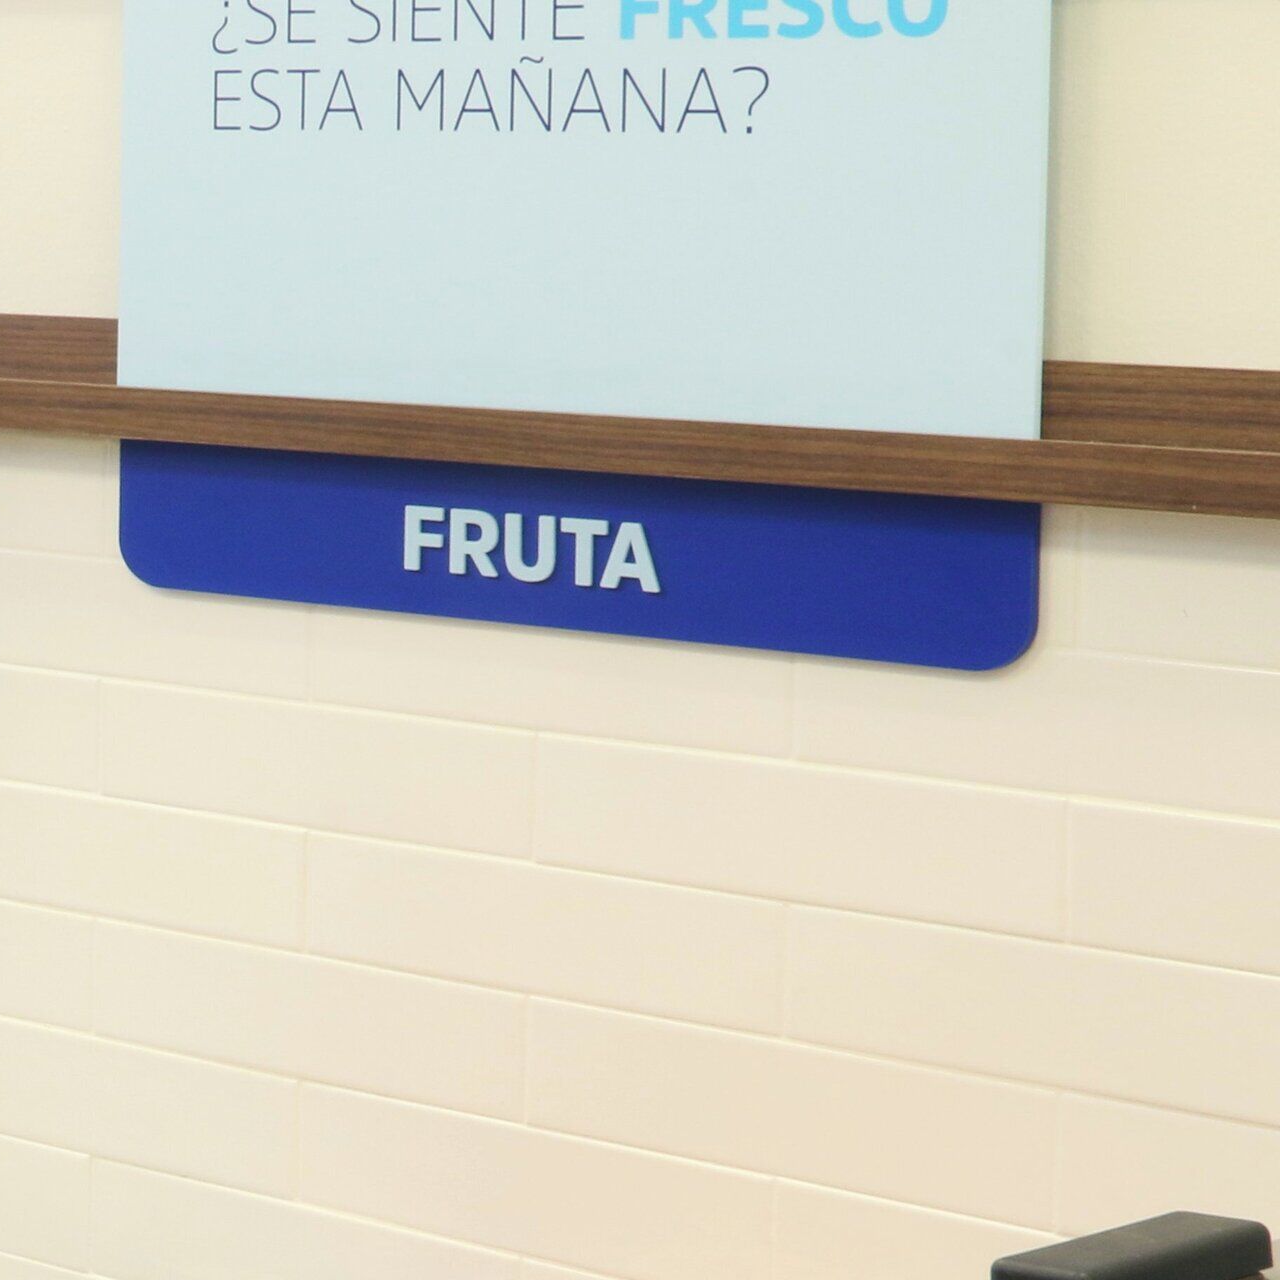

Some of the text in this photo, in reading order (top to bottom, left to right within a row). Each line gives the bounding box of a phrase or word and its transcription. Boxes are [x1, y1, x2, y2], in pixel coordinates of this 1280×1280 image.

[212, 0, 949, 54] ¿SE SIENTE FRESCO
[213, 55, 770, 135] ESTA MAÑANA?
[403, 504, 662, 595] FRUTA
